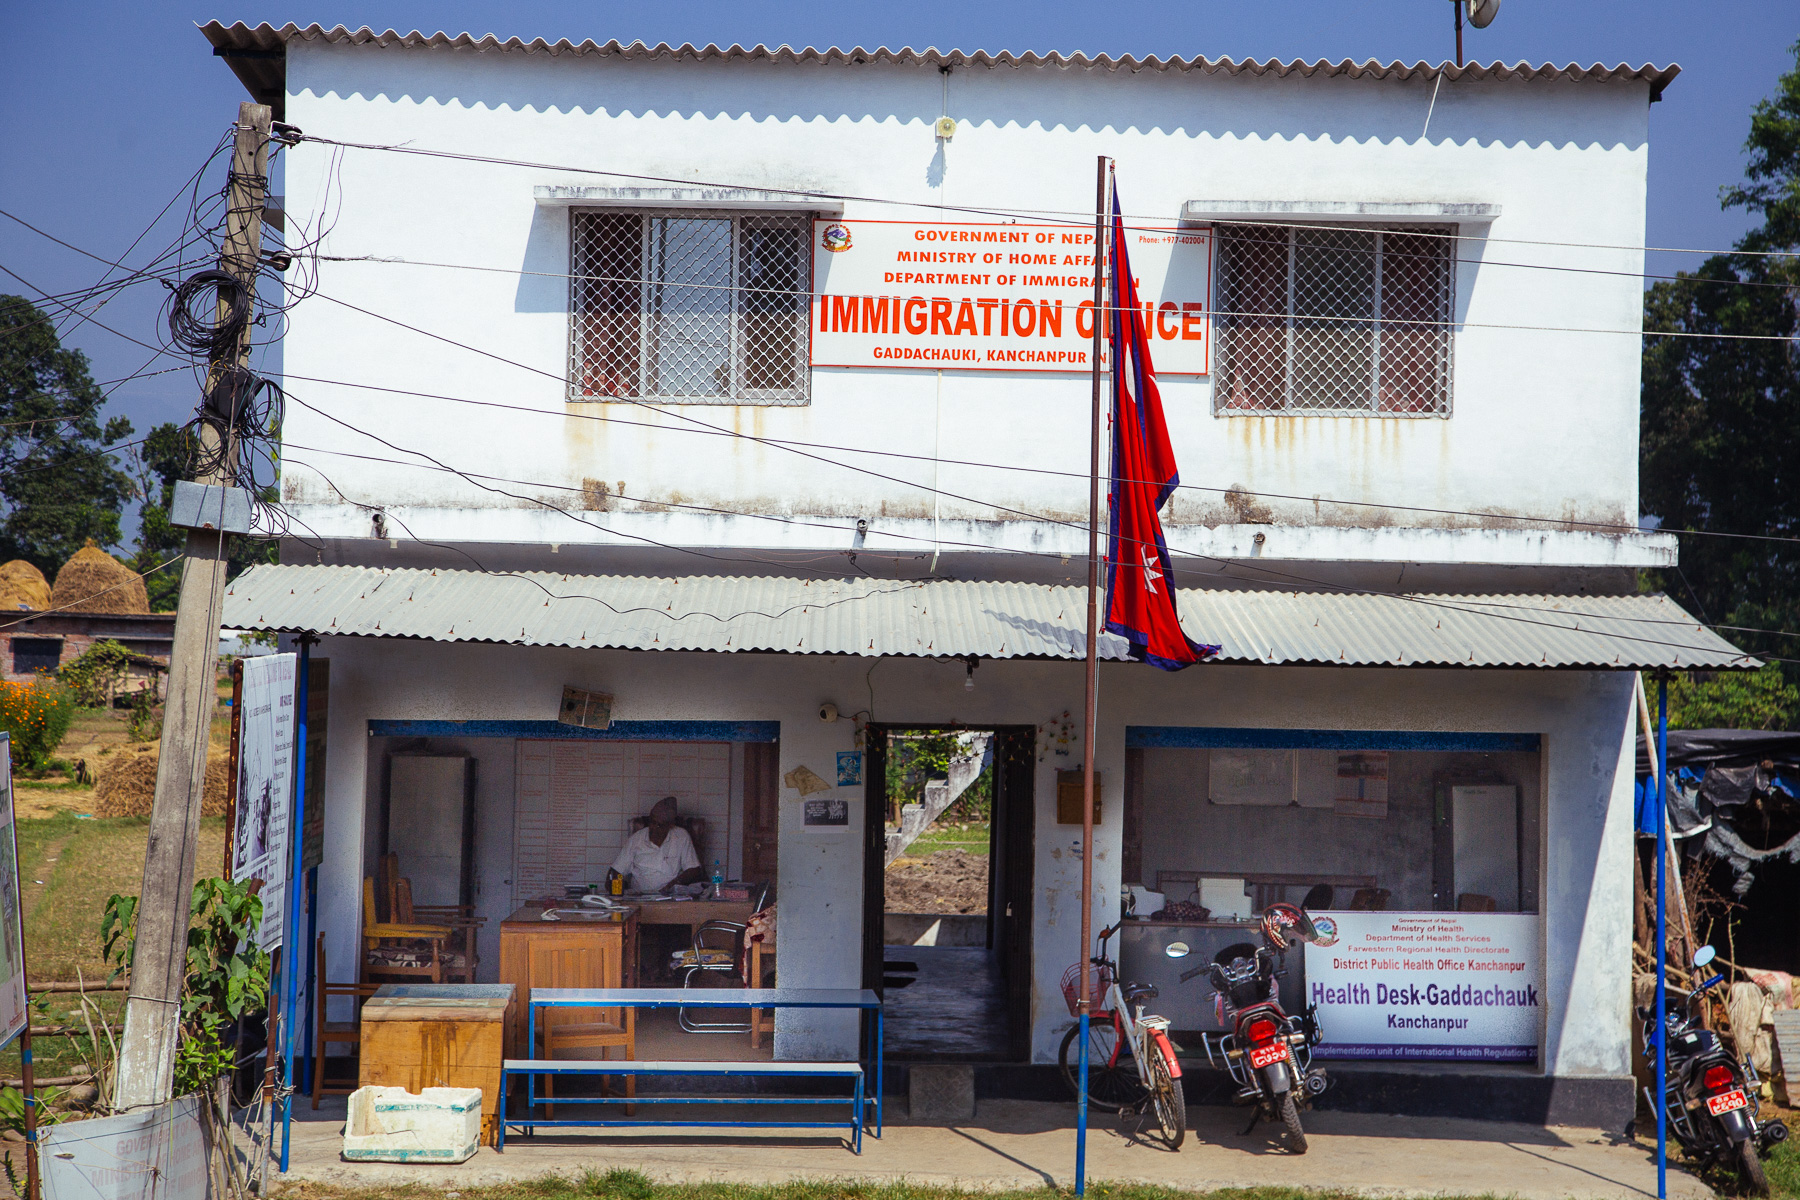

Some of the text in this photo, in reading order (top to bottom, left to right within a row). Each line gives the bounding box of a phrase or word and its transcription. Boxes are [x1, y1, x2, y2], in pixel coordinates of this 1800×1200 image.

[915, 229, 1028, 243] GOVERNMENT
[1034, 232, 1055, 244] OF
[1138, 235, 1205, 245] Phone: +977-402004
[897, 250, 976, 264] MINISTRY
[983, 252, 1002, 264] OF
[1008, 253, 1056, 265] HOME
[884, 271, 991, 286] DEPARTMENT
[997, 274, 1017, 287] OF
[820, 294, 1203, 341] IMMIGRATION OICE
[873, 346, 982, 363] GADDACHAUKI,
[986, 349, 1087, 364] KANCHANPUR
[1391, 924, 1465, 934] Ministry of Health
[1365, 933, 1491, 943] Department of Health Services
[1348, 945, 1510, 954] Farwestern Regional Health Directorate
[1333, 958, 1526, 974] District Public Health Office Kanchanpur
[1312, 982, 1370, 1004] Health
[1388, 1014, 1469, 1033] Kanchanpur
[1311, 1045, 1376, 1056] (Implementation
[1377, 1047, 1393, 1055] unit
[1394, 1046, 1403, 1055] of
[1404, 1047, 1454, 1056] International
[1456, 1048, 1482, 1056] Health
[1483, 1048, 1527, 1058] Regulation
